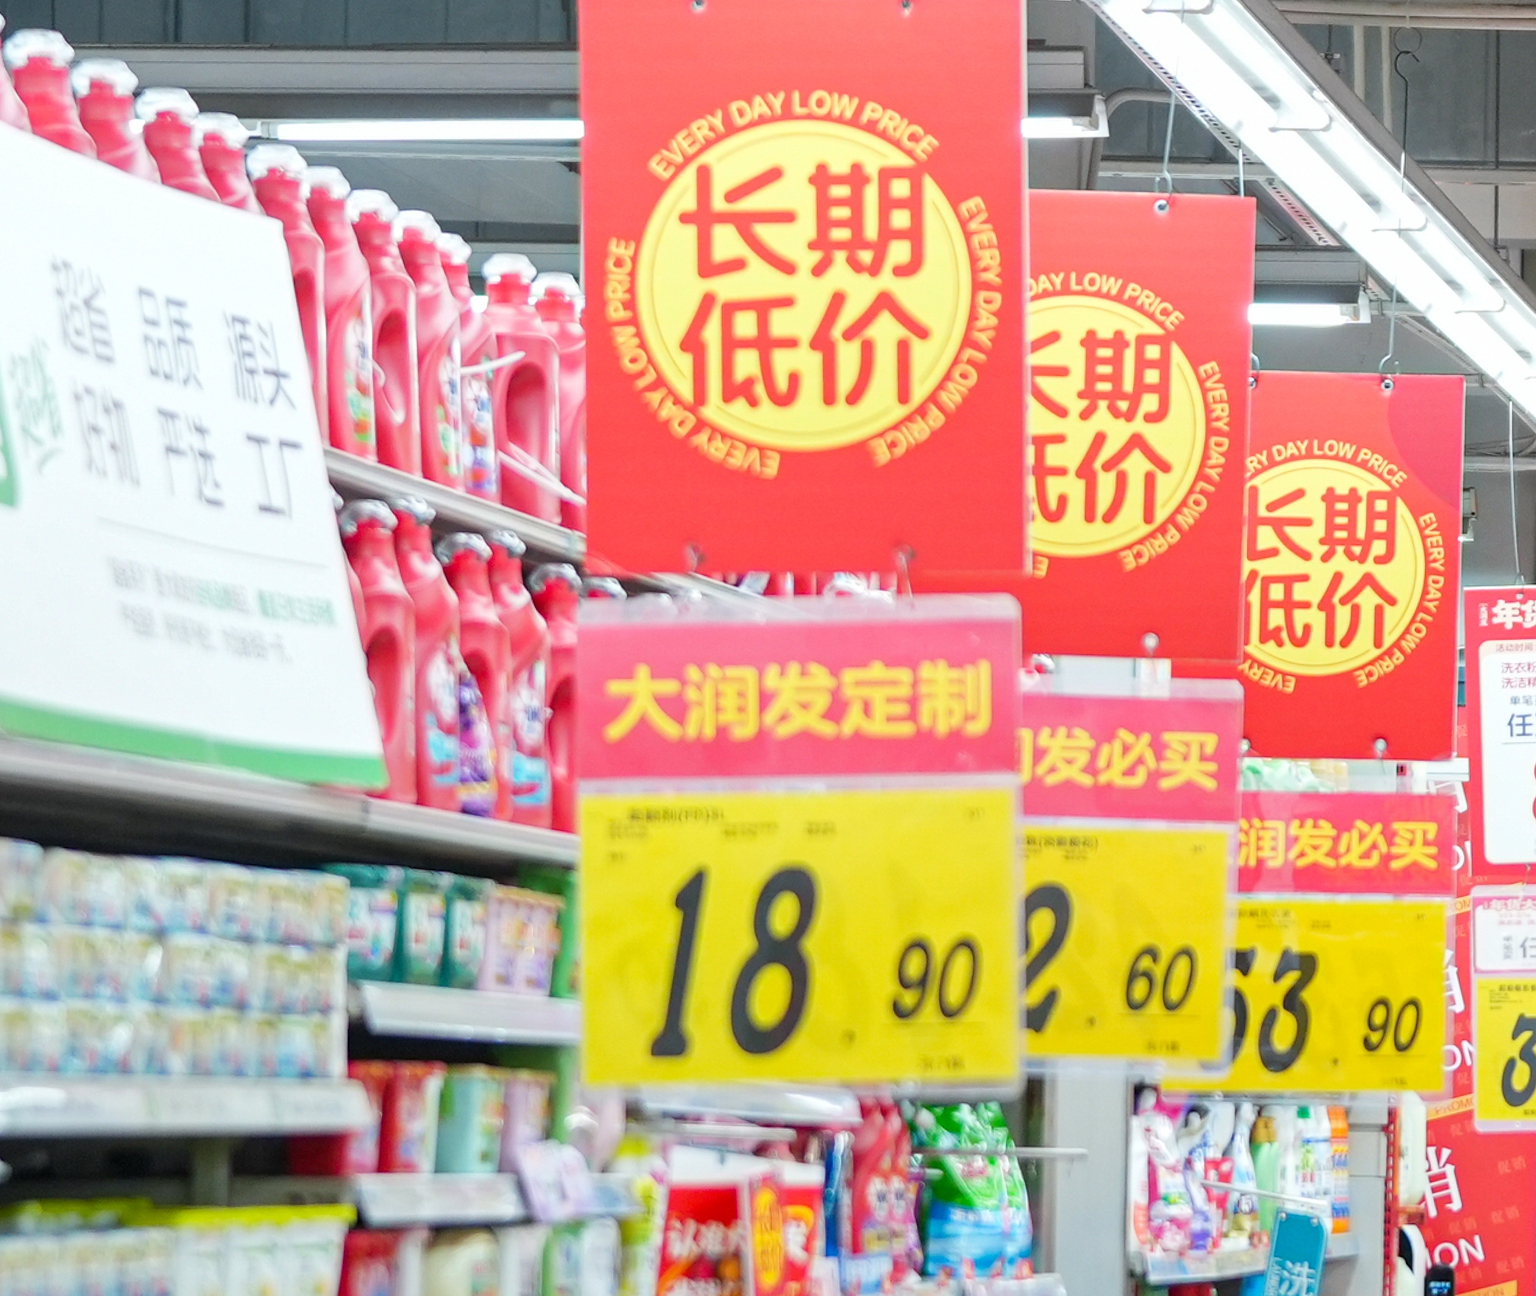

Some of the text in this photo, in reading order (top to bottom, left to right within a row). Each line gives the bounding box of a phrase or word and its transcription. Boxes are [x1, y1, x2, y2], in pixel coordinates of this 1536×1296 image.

[647, 90, 939, 183] EVERY DAY LOW PRICE
[679, 163, 926, 279] 长期
[864, 195, 1003, 469] EVERY DAY LOW PRICE
[1070, 272, 1122, 296] LOW
[1123, 282, 1185, 332] PRICE
[606, 237, 781, 480] EVERY DAY LOW PRICE
[679, 289, 932, 409] 低价
[1118, 361, 1231, 573] EVERY DAY LOW PRICE
[1272, 439, 1408, 489] DAY LOW PRICE
[1247, 485, 1398, 565] 长期
[1244, 569, 1399, 649] 低价
[1353, 512, 1446, 689] EVERY DAY LOW PRICE
[604, 657, 993, 742] 大润发定制
[1238, 659, 1297, 694] EVERY
[1020, 728, 1219, 789] 发必买
[650, 866, 979, 1059] 18 90
[1124, 943, 1198, 1012] 60
[1362, 997, 1422, 1053] 90
